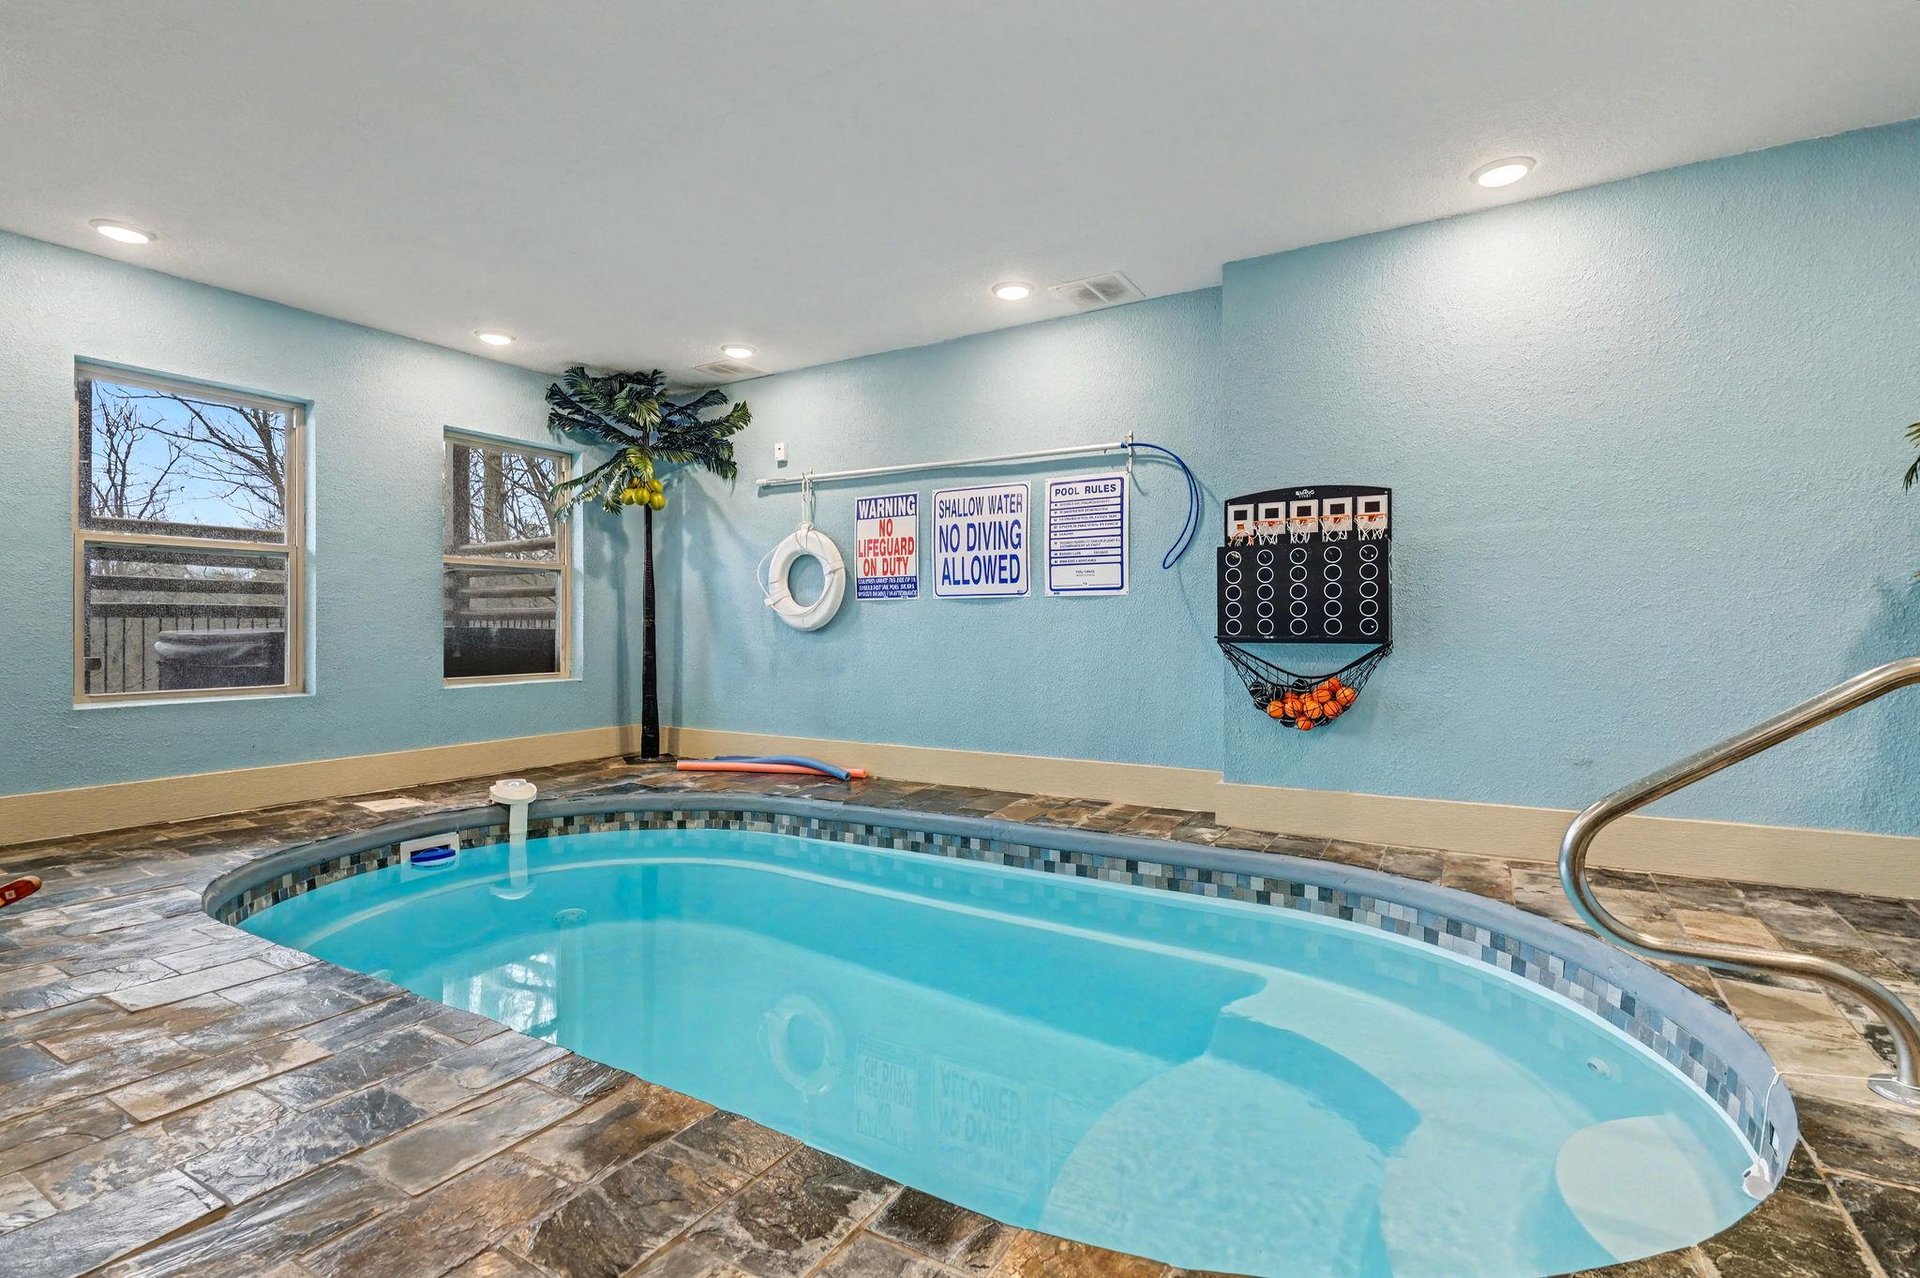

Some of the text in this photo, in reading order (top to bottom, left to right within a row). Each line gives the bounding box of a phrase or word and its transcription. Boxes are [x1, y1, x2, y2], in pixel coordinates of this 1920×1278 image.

[1054, 483, 1117, 497] POOL RULES
[858, 495, 916, 519] WARNING
[938, 493, 1023, 519] SHALLOW WATER
[879, 518, 894, 537] NO
[939, 519, 1022, 553] NO DIVING
[858, 536, 915, 558] LIFEGUARD
[863, 556, 909, 577] ON DUTY
[941, 553, 1020, 586] ALLOWED
